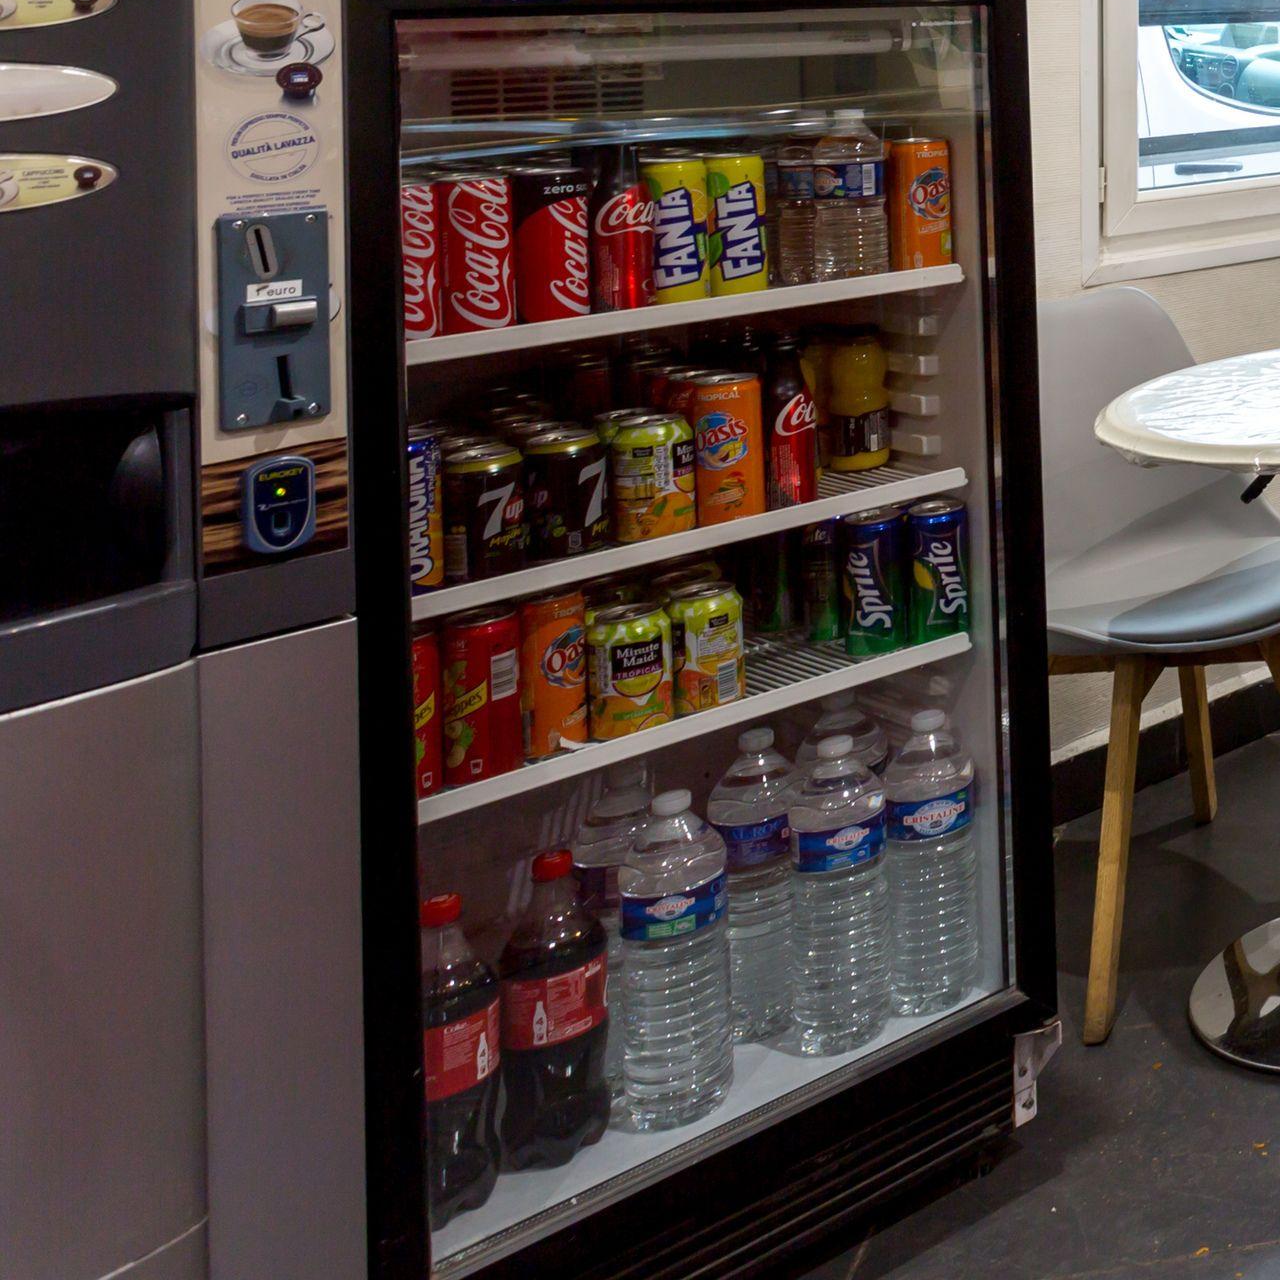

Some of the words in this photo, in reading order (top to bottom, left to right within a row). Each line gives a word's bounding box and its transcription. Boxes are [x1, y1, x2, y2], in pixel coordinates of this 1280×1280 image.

[231, 142, 272, 159] QUALITÀ
[274, 135, 315, 150] LAVAZZA
[543, 184, 574, 196] zero
[716, 181, 763, 280] FANTA
[267, 286, 296, 297] euro
[477, 481, 515, 540] 7
[505, 499, 524, 519] up
[928, 540, 967, 614] Sprite
[849, 550, 892, 629] Sprite
[617, 643, 660, 659] Minute
[617, 664, 661, 680] TROPICAL
[904, 802, 965, 826] CRISTALINE
[826, 828, 869, 845] CRISTALINE
